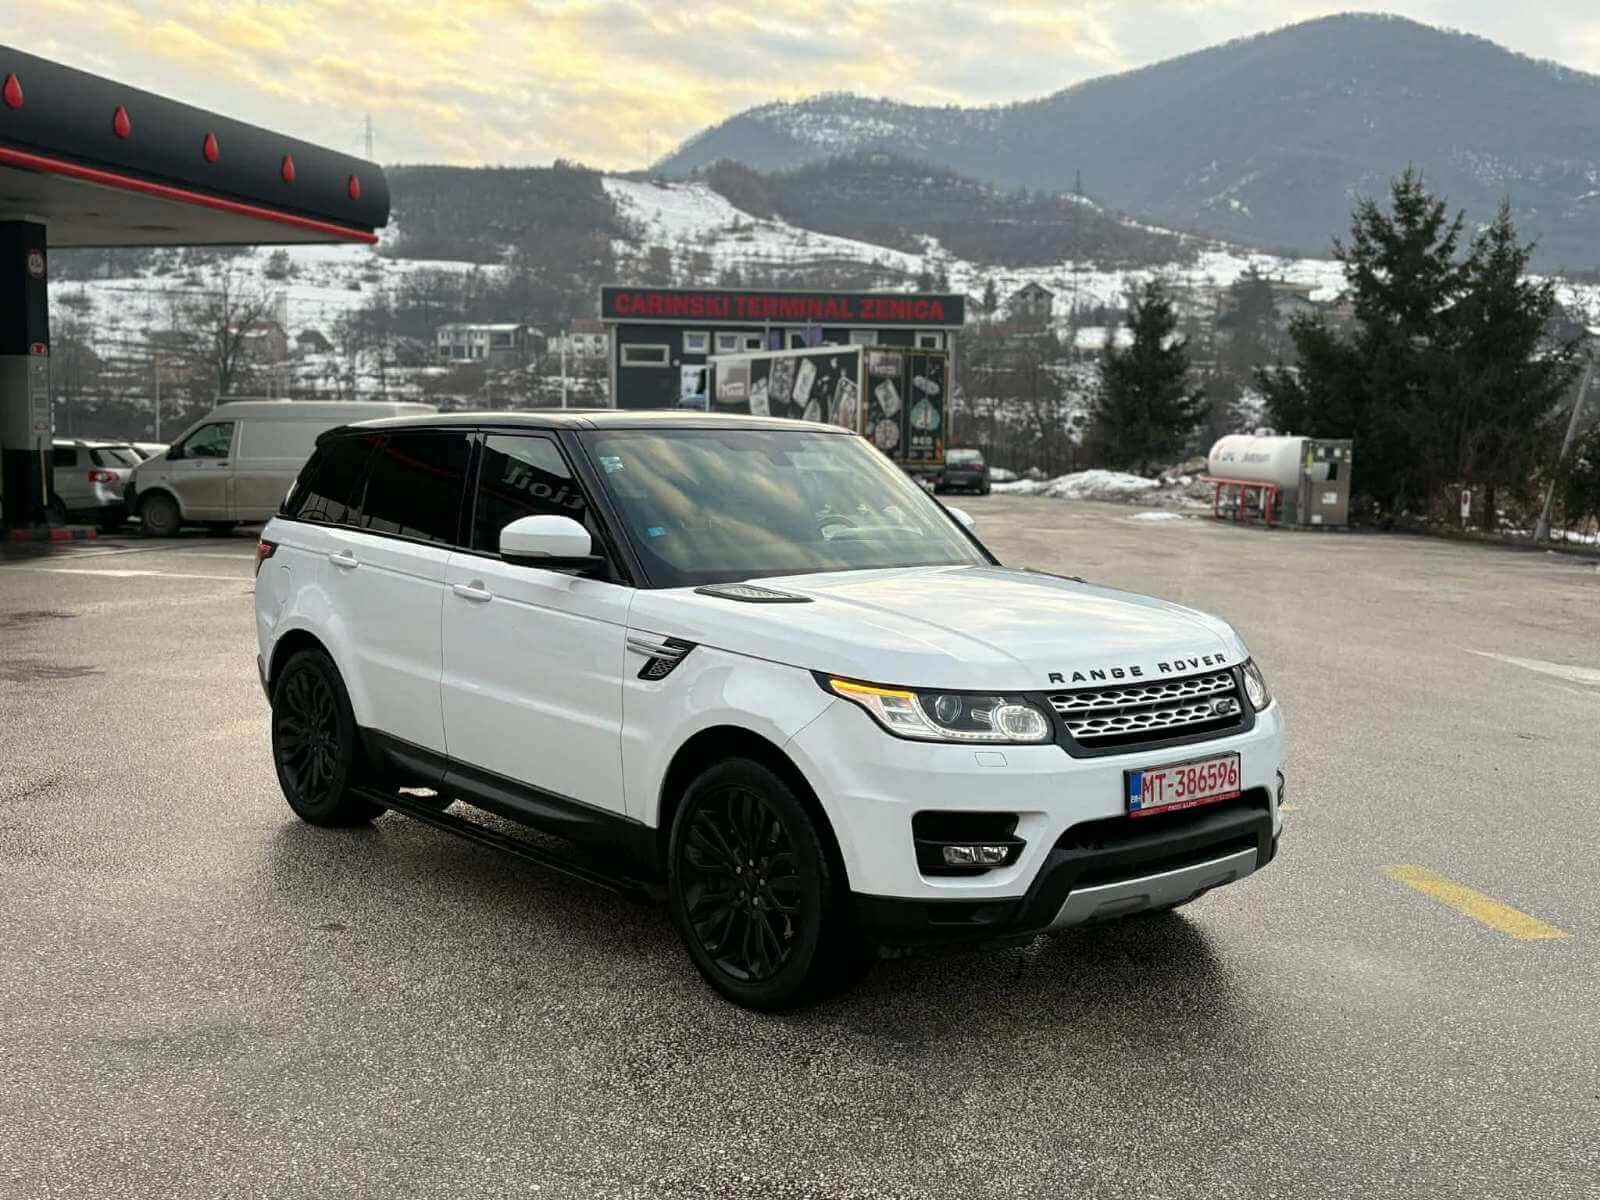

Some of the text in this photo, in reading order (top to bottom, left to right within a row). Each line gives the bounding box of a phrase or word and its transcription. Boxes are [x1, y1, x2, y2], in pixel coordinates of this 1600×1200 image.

[615, 293, 944, 321] CARINSKI TERMINAL ZENICA
[1048, 653, 1226, 684] RANGE ROVER
[1142, 760, 1237, 802] MT-386596
